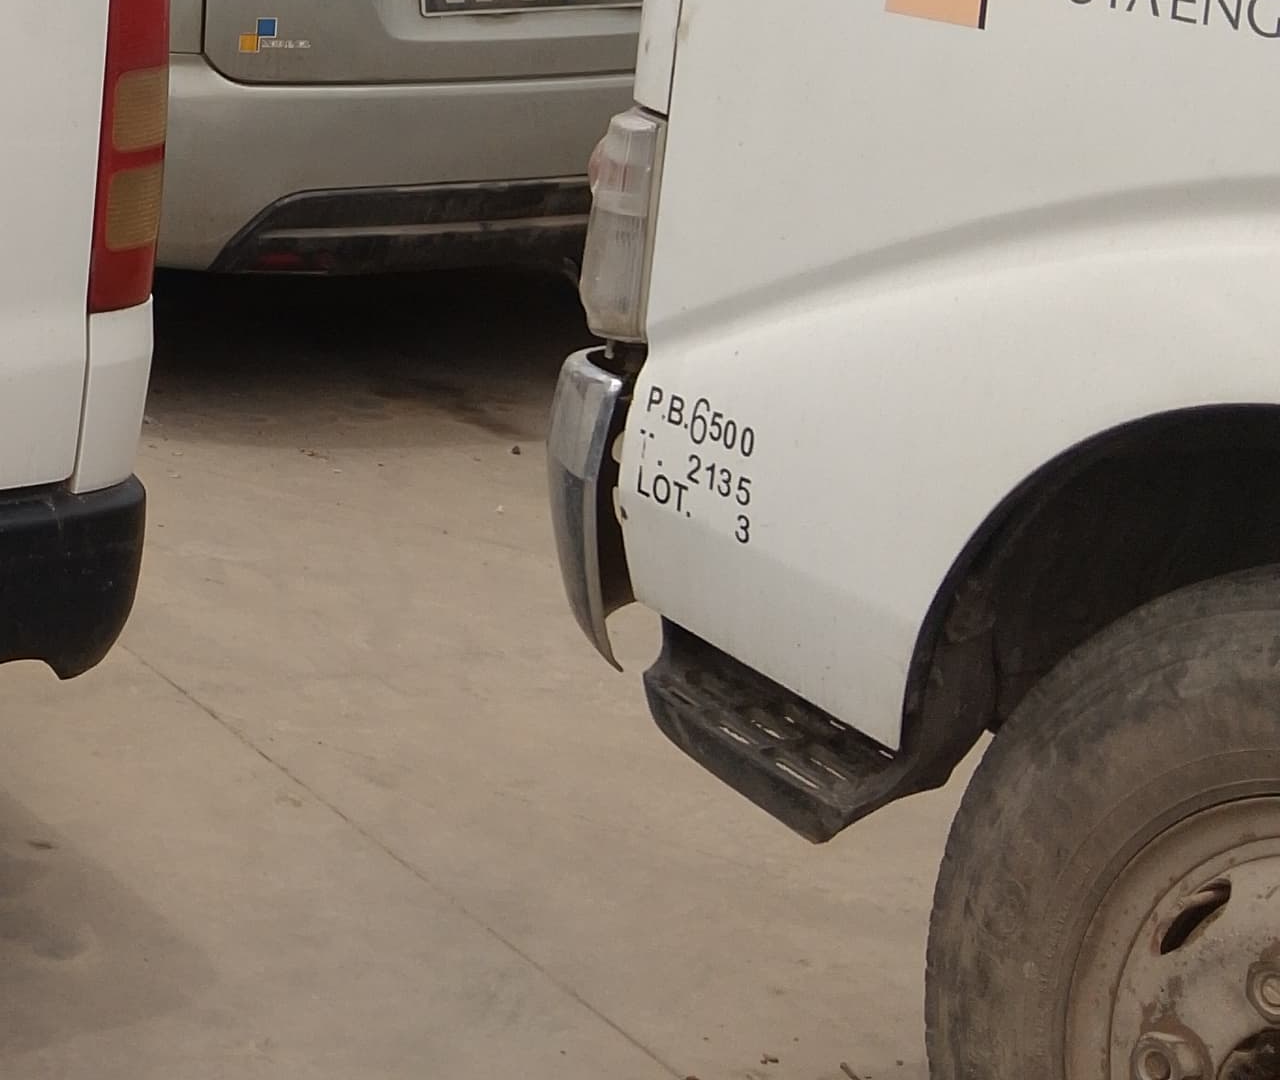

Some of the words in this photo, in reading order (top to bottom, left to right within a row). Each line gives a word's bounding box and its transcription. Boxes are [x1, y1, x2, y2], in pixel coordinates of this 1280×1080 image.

[637, 464, 691, 518] LOT.
[735, 515, 750, 543] 3
[686, 454, 752, 506] 2135
